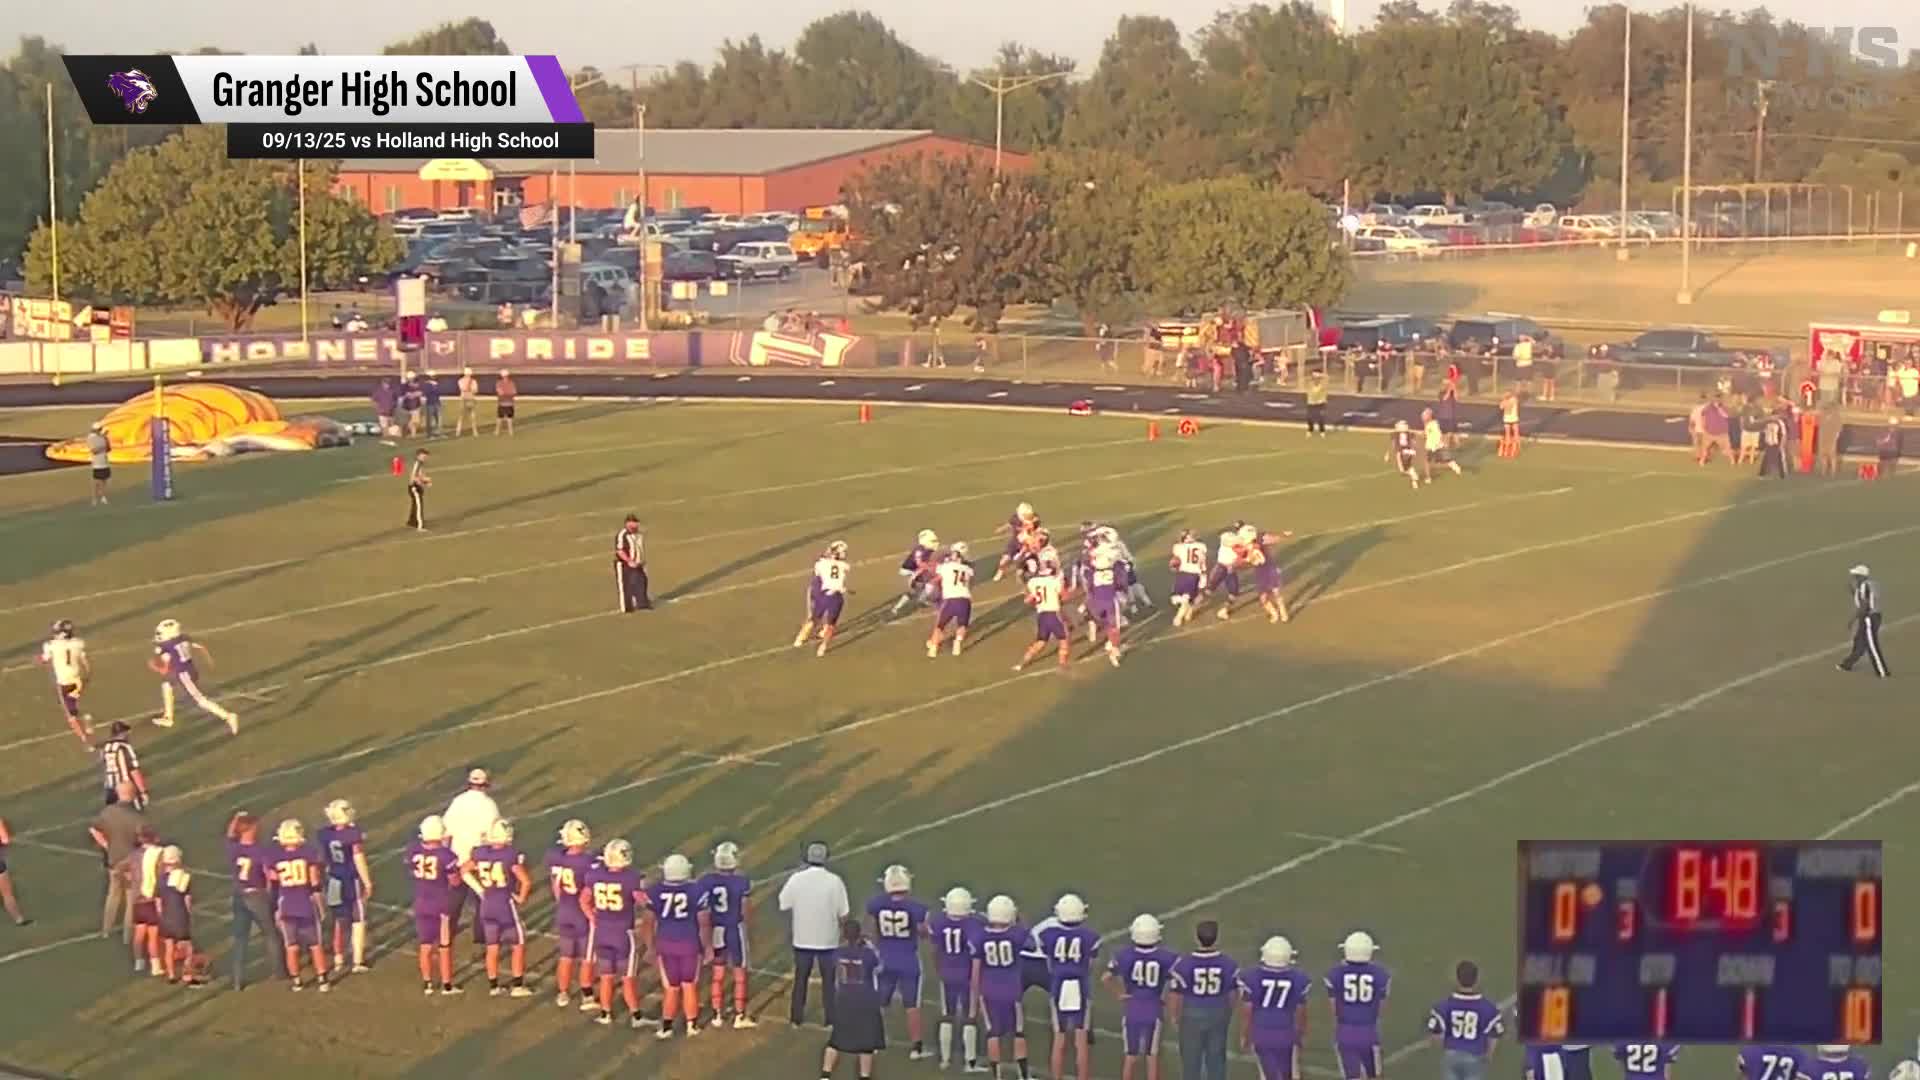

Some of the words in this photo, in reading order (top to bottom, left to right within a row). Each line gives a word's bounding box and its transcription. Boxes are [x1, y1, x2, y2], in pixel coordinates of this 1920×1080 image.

[490, 338, 649, 360] PRIDE
[329, 840, 346, 864] 6
[236, 856, 252, 881] 7
[275, 858, 308, 888] 20
[411, 853, 438, 880] 33
[476, 861, 508, 888] 54
[551, 866, 578, 895] 79
[593, 882, 624, 911] 65
[659, 892, 689, 919] 72
[713, 886, 729, 913] 3
[878, 909, 910, 938] 62
[1553, 881, 1577, 940] 0
[1854, 882, 1877, 941] 0
[943, 928, 962, 954] 11
[983, 940, 1015, 967] 80
[1054, 936, 1082, 963] 44
[1131, 960, 1160, 987] 40
[1193, 967, 1222, 995] 55
[1261, 979, 1292, 1009] 77
[1343, 973, 1373, 1002] 56
[1450, 1010, 1479, 1040] 58
[1845, 988, 1873, 1042] 10
[1626, 1044, 1658, 1073] 22
[1762, 1054, 1795, 1080] 73
